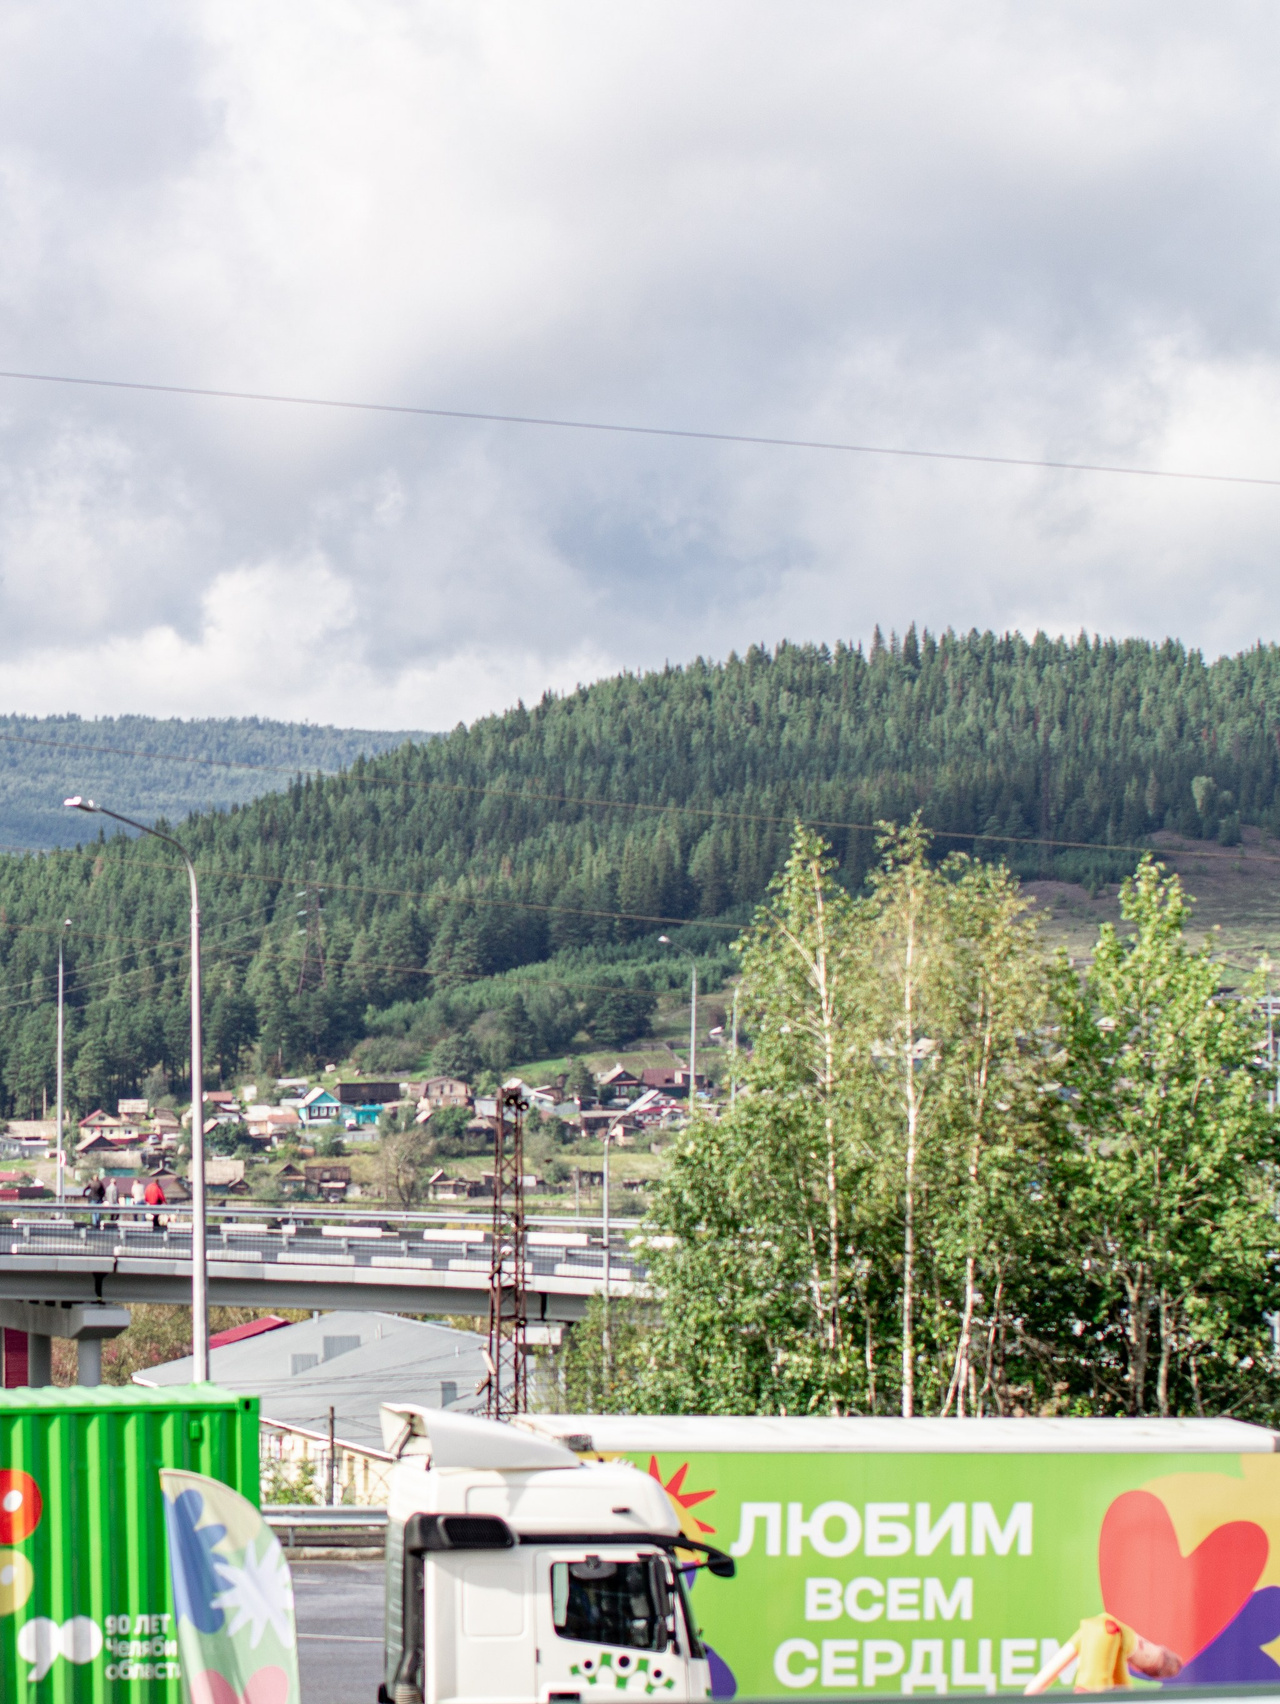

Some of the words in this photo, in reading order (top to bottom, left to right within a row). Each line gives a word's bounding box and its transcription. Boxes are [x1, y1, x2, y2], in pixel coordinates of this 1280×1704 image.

[728, 1500, 1033, 1557] ЛЮБИМ
[805, 1576, 974, 1622] ВСЕМ
[104, 1614, 131, 1636] 90
[133, 1614, 172, 1635] ЛЕТ
[105, 1635, 178, 1659] Челяби
